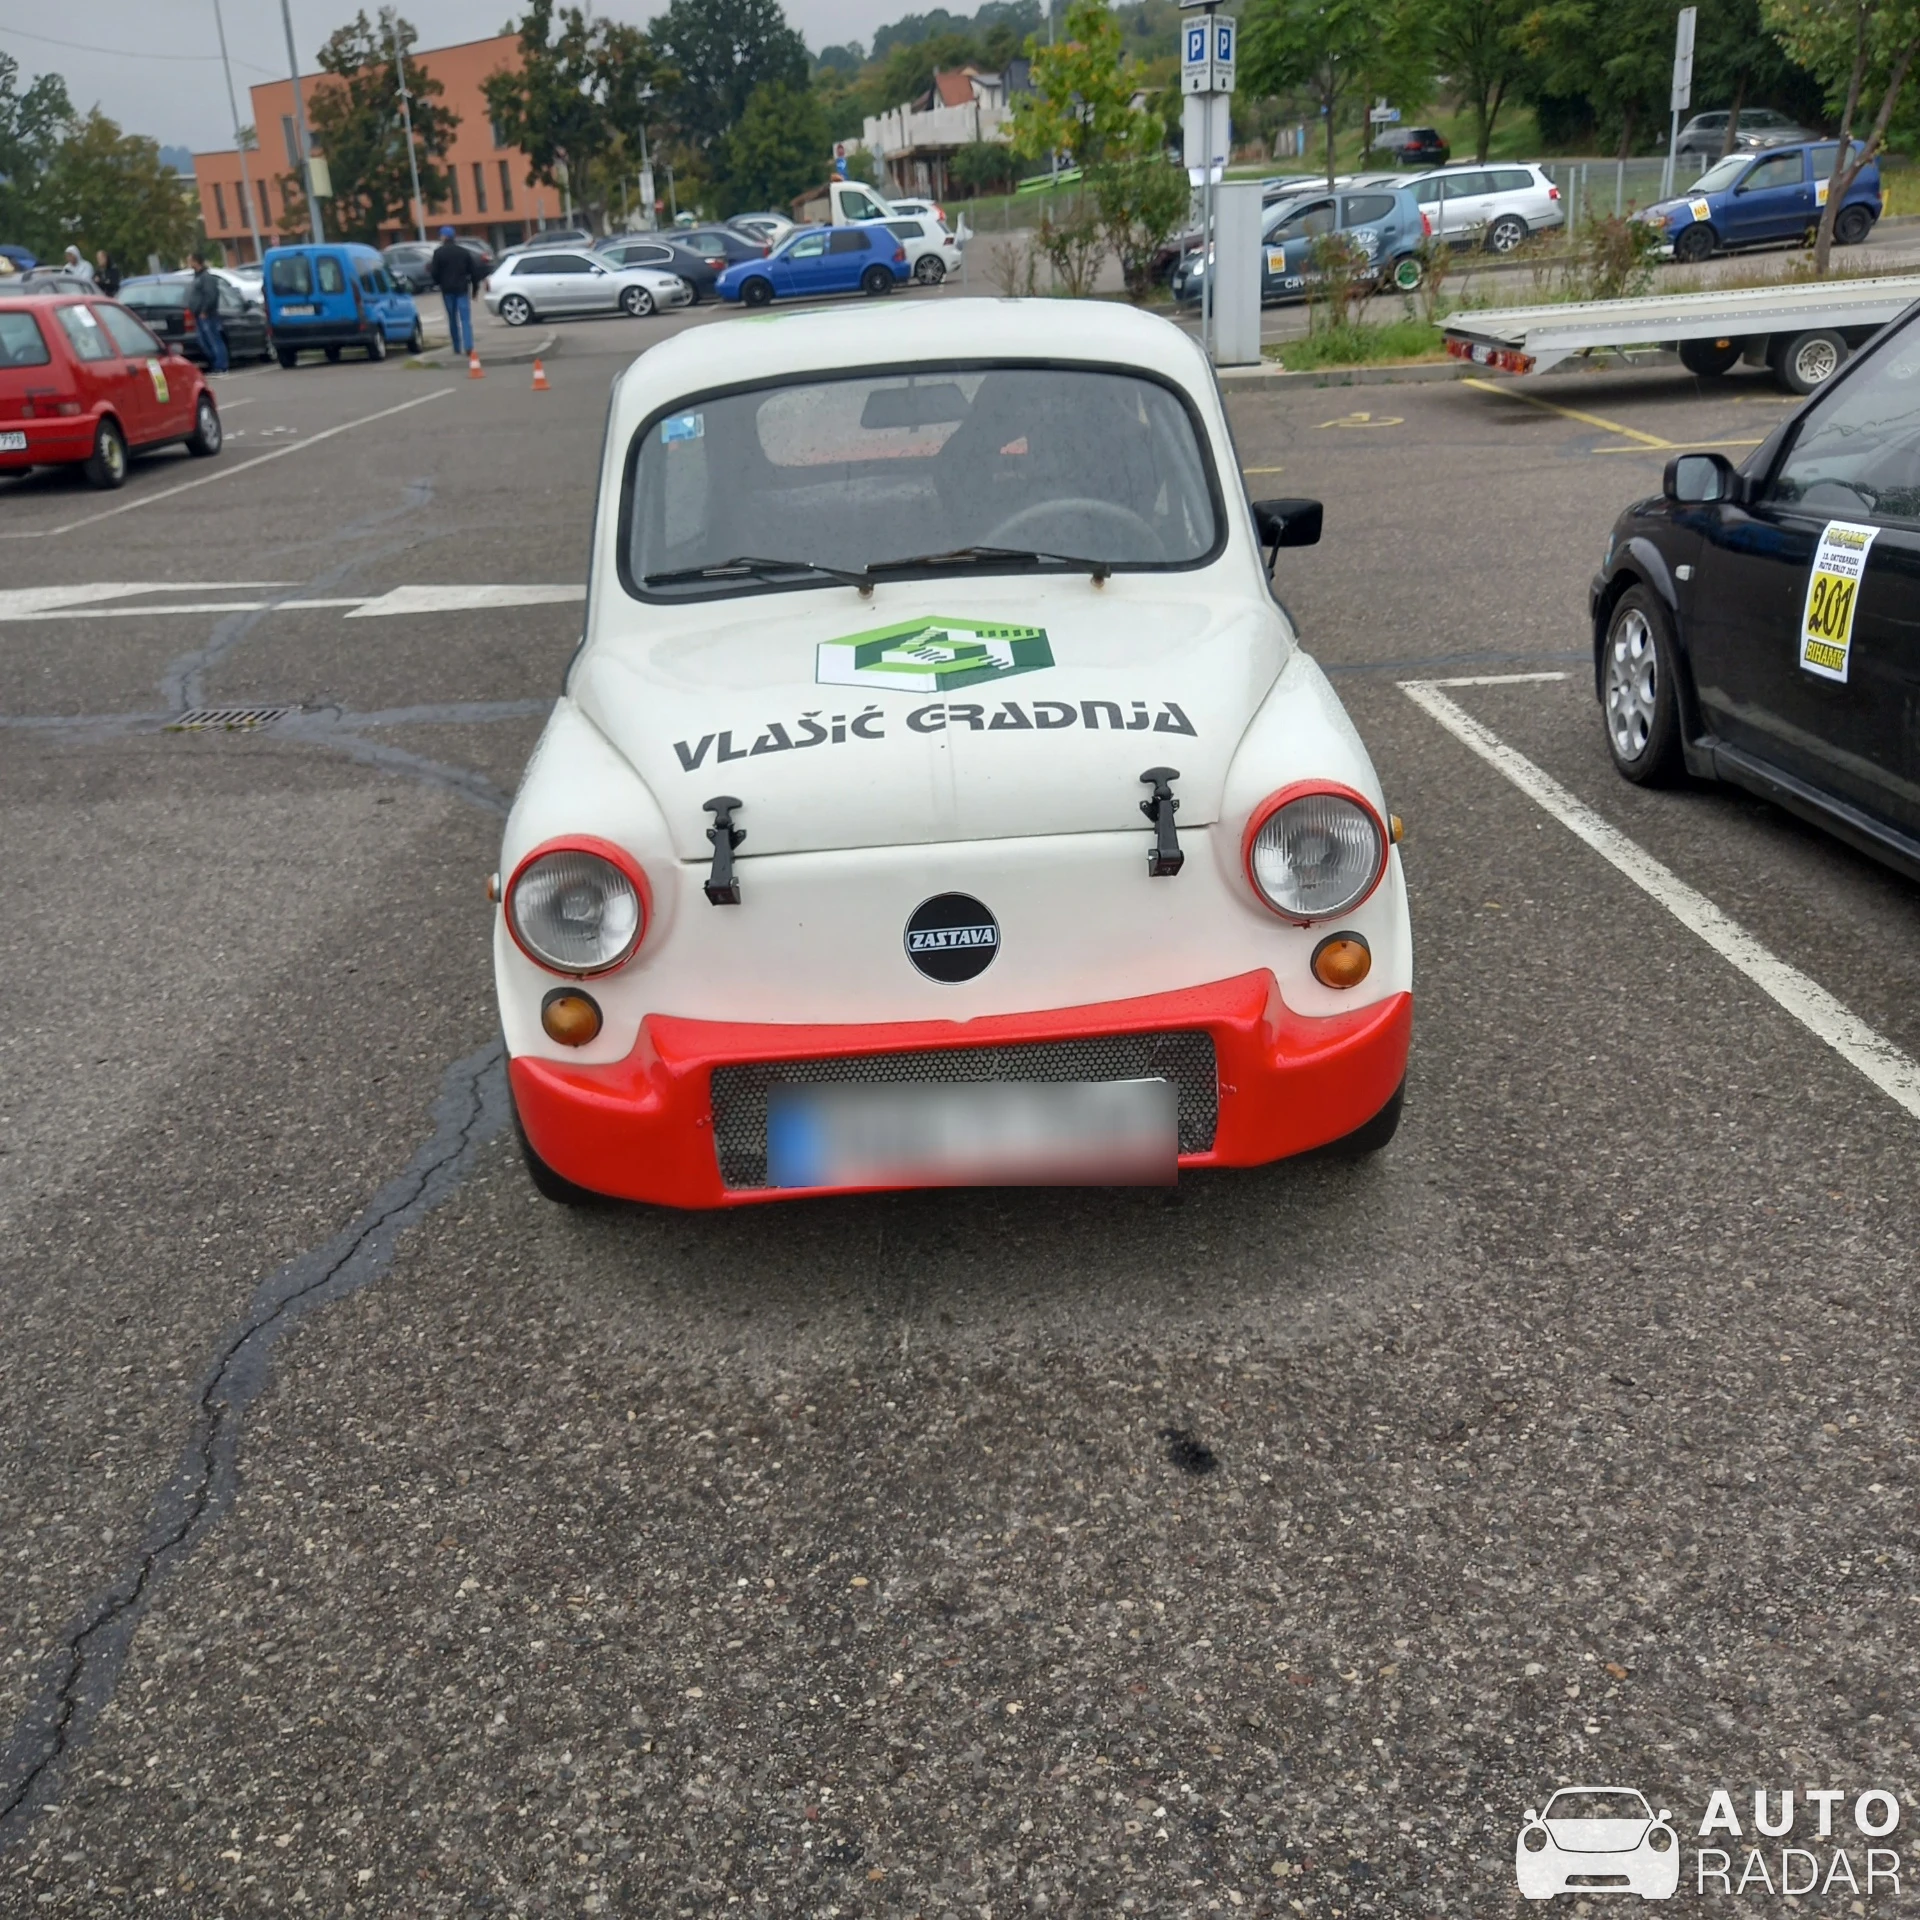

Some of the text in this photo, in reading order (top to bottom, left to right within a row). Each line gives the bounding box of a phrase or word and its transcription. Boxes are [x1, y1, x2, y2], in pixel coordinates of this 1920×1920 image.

[1191, 33, 1201, 59] P
[1220, 32, 1228, 57] P
[1808, 577, 1855, 639] 201
[1805, 640, 1847, 672] BIHAMK
[912, 928, 993, 949] ZASTAVA
